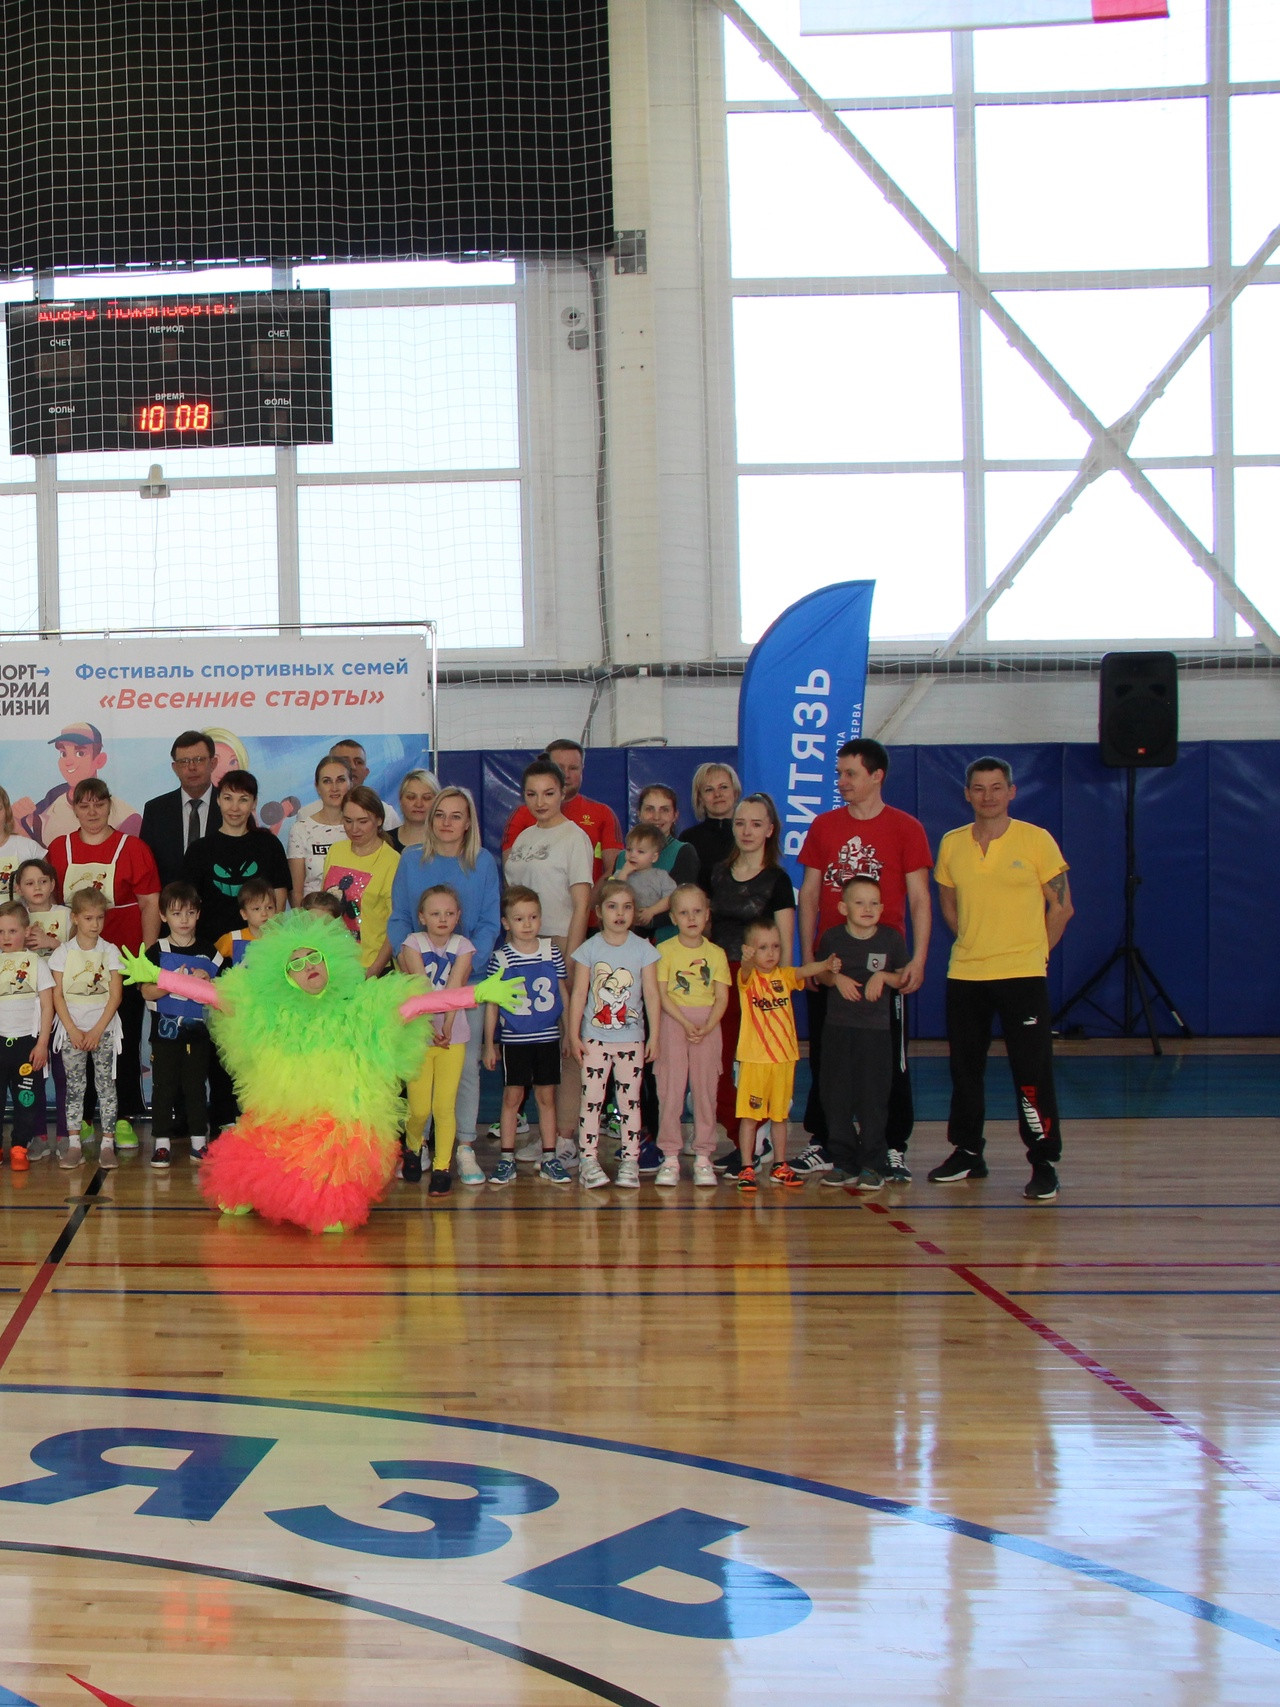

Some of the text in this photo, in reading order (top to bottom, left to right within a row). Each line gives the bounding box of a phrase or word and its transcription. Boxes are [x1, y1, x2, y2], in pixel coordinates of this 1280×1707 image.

[149, 325, 185, 334] ПЕРИОД
[268, 330, 290, 338] СЧЕТ
[50, 339, 72, 347] СЧЕТ
[155, 393, 185, 401] ВРЕМЯ
[264, 398, 291, 406] ФОЛЫ
[48, 406, 75, 414] ФОЛЫ
[140, 403, 210, 431] 10 08
[75, 658, 409, 680] Фестиваль спортивных семей
[99, 688, 385, 710] «Весенние старты»
[783, 668, 831, 857] ВИТЯЗЬ
